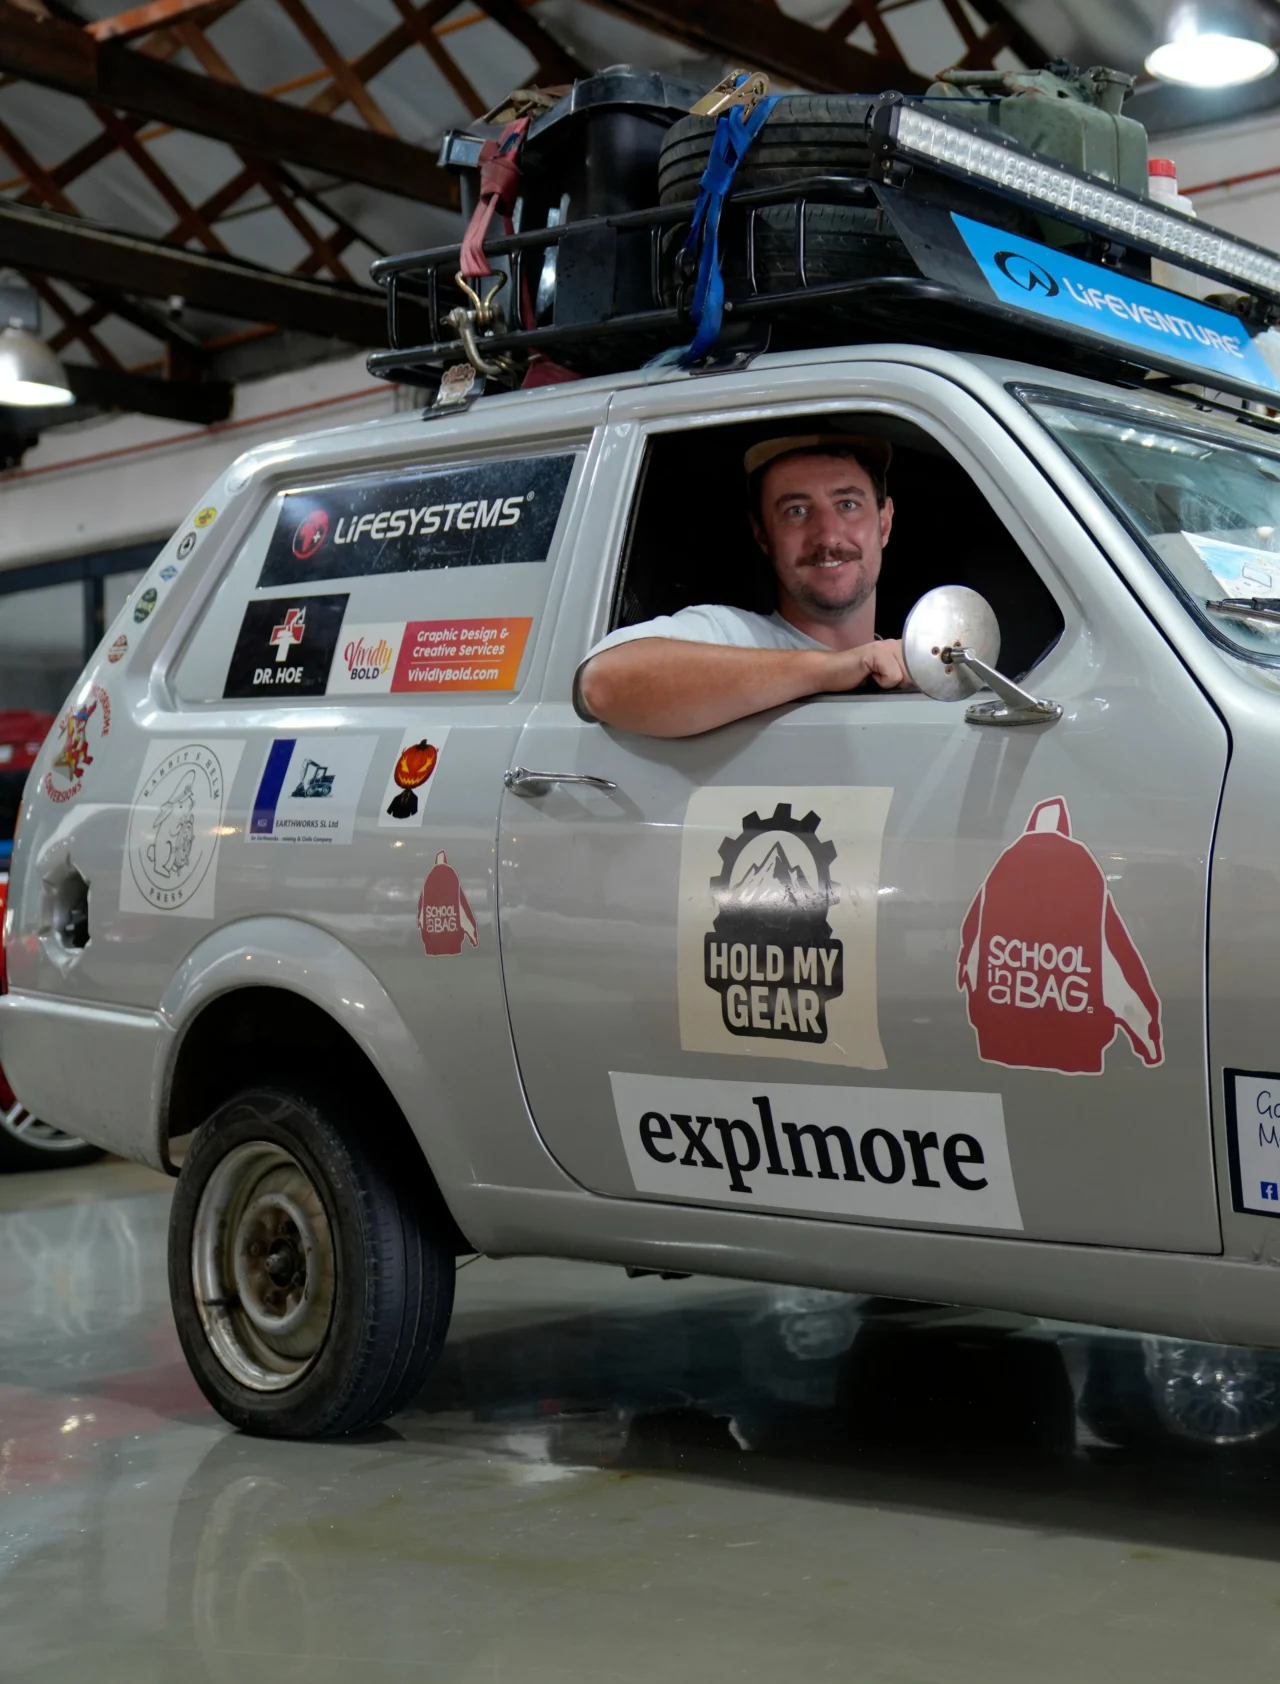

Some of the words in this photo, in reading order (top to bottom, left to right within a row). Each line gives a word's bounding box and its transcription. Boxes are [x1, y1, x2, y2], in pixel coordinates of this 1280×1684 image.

[417, 627, 459, 645] Graphic
[460, 626, 497, 642] Design
[500, 628, 509, 640] &
[344, 637, 393, 674] Vividly
[413, 643, 456, 658] Creative
[458, 642, 505, 656] Services
[253, 667, 274, 685] DR.
[275, 667, 303, 684] HOE
[350, 668, 380, 680] BOLD
[408, 667, 499, 683] VividlyBold.com
[205, 759, 220, 800] HELM
[275, 819, 319, 828] EARTHWORKS
[320, 820, 327, 828] SL
[328, 819, 339, 828] Ltd
[313, 836, 332, 844] Company
[149, 887, 183, 903] PRESS
[425, 905, 457, 918] SCHOOL
[434, 917, 457, 933] BAG
[987, 935, 1091, 974] SCHOOL
[710, 942, 784, 982] HOLD
[793, 946, 839, 986] MY
[988, 964, 1011, 986] in
[988, 985, 1011, 1005] a
[1015, 971, 1088, 1013] BAG
[726, 984, 822, 1034] GEAR
[639, 1095, 989, 1194] explmore
